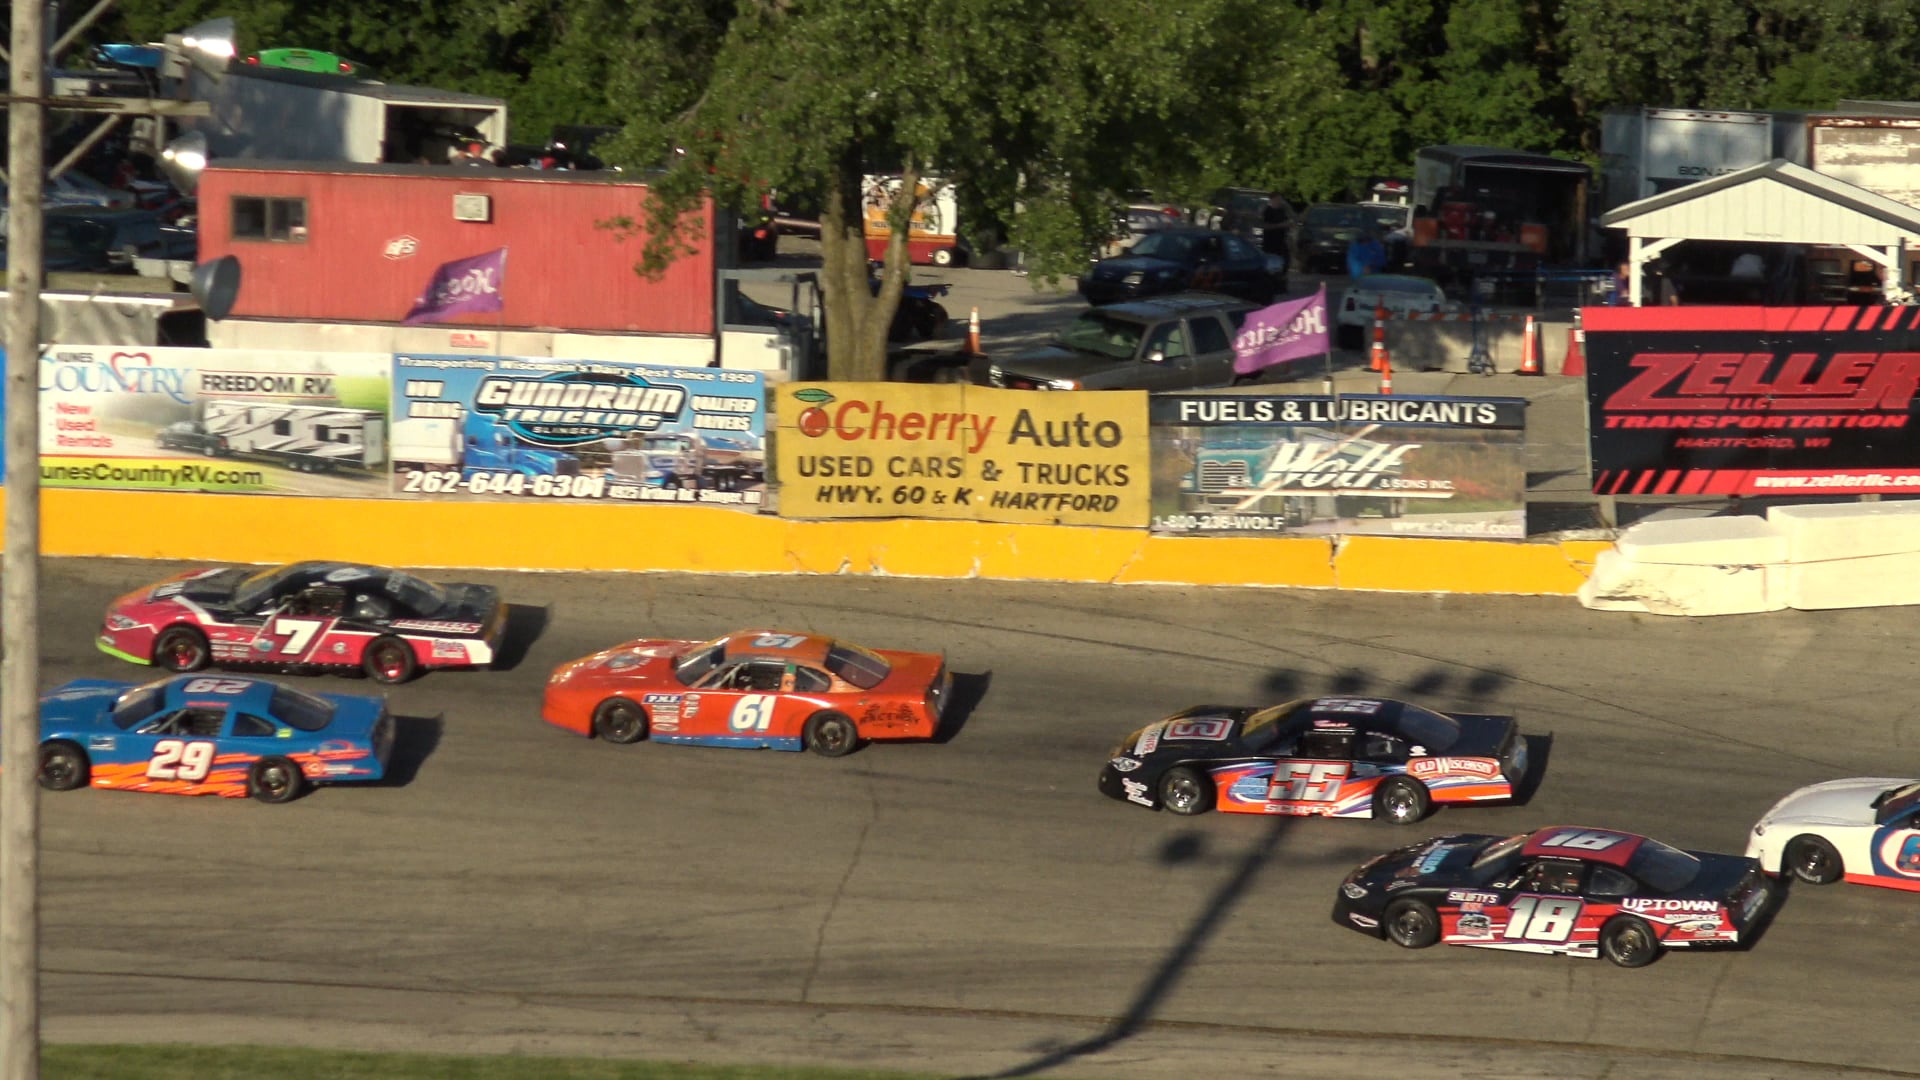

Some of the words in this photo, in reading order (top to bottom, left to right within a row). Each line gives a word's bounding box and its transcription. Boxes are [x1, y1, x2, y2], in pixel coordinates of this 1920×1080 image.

[202, 373, 294, 394] FREEDOM
[302, 374, 332, 395] RV
[634, 366, 670, 379] Best
[673, 369, 715, 381] Since
[719, 372, 757, 384] 1950
[1603, 352, 1920, 410] ZELLER
[476, 380, 684, 414] GUNDRUM
[1729, 397, 1772, 410] LLC
[56, 403, 91, 416] New
[503, 408, 662, 428] TRUCKING
[1180, 401, 1275, 421] FUELS
[1281, 401, 1304, 421] &
[1309, 400, 1497, 424] LUBRICANTS
[1604, 414, 1910, 428] TRANSPORTATION
[56, 419, 95, 433] Used
[834, 400, 996, 454] Cherry
[1007, 408, 1122, 448] Auto
[56, 435, 113, 449] Rentals
[1803, 437, 1832, 448] WI
[39, 463, 264, 486] unesCountryRV.com
[797, 455, 873, 478] USED
[888, 456, 963, 479] CARS
[980, 459, 1003, 482] &
[1017, 461, 1130, 487] TRUCKS
[1258, 442, 1423, 488] Wolf
[1379, 478, 1391, 488] &
[1391, 479, 1427, 489] SONS
[403, 470, 605, 498] 262-644-6301
[816, 485, 882, 504] HWY.
[892, 485, 925, 504] 60
[932, 489, 947, 504] &
[953, 487, 973, 506] K
[989, 489, 1119, 513] HARTFORD
[275, 619, 322, 655] 7
[730, 693, 777, 732] 61
[145, 739, 216, 782] 29
[1414, 759, 1436, 773] OLD
[1268, 762, 1348, 801] 55
[1540, 829, 1630, 851] 18
[1622, 898, 1719, 912] UPTOWN
[1503, 896, 1572, 942] 18
